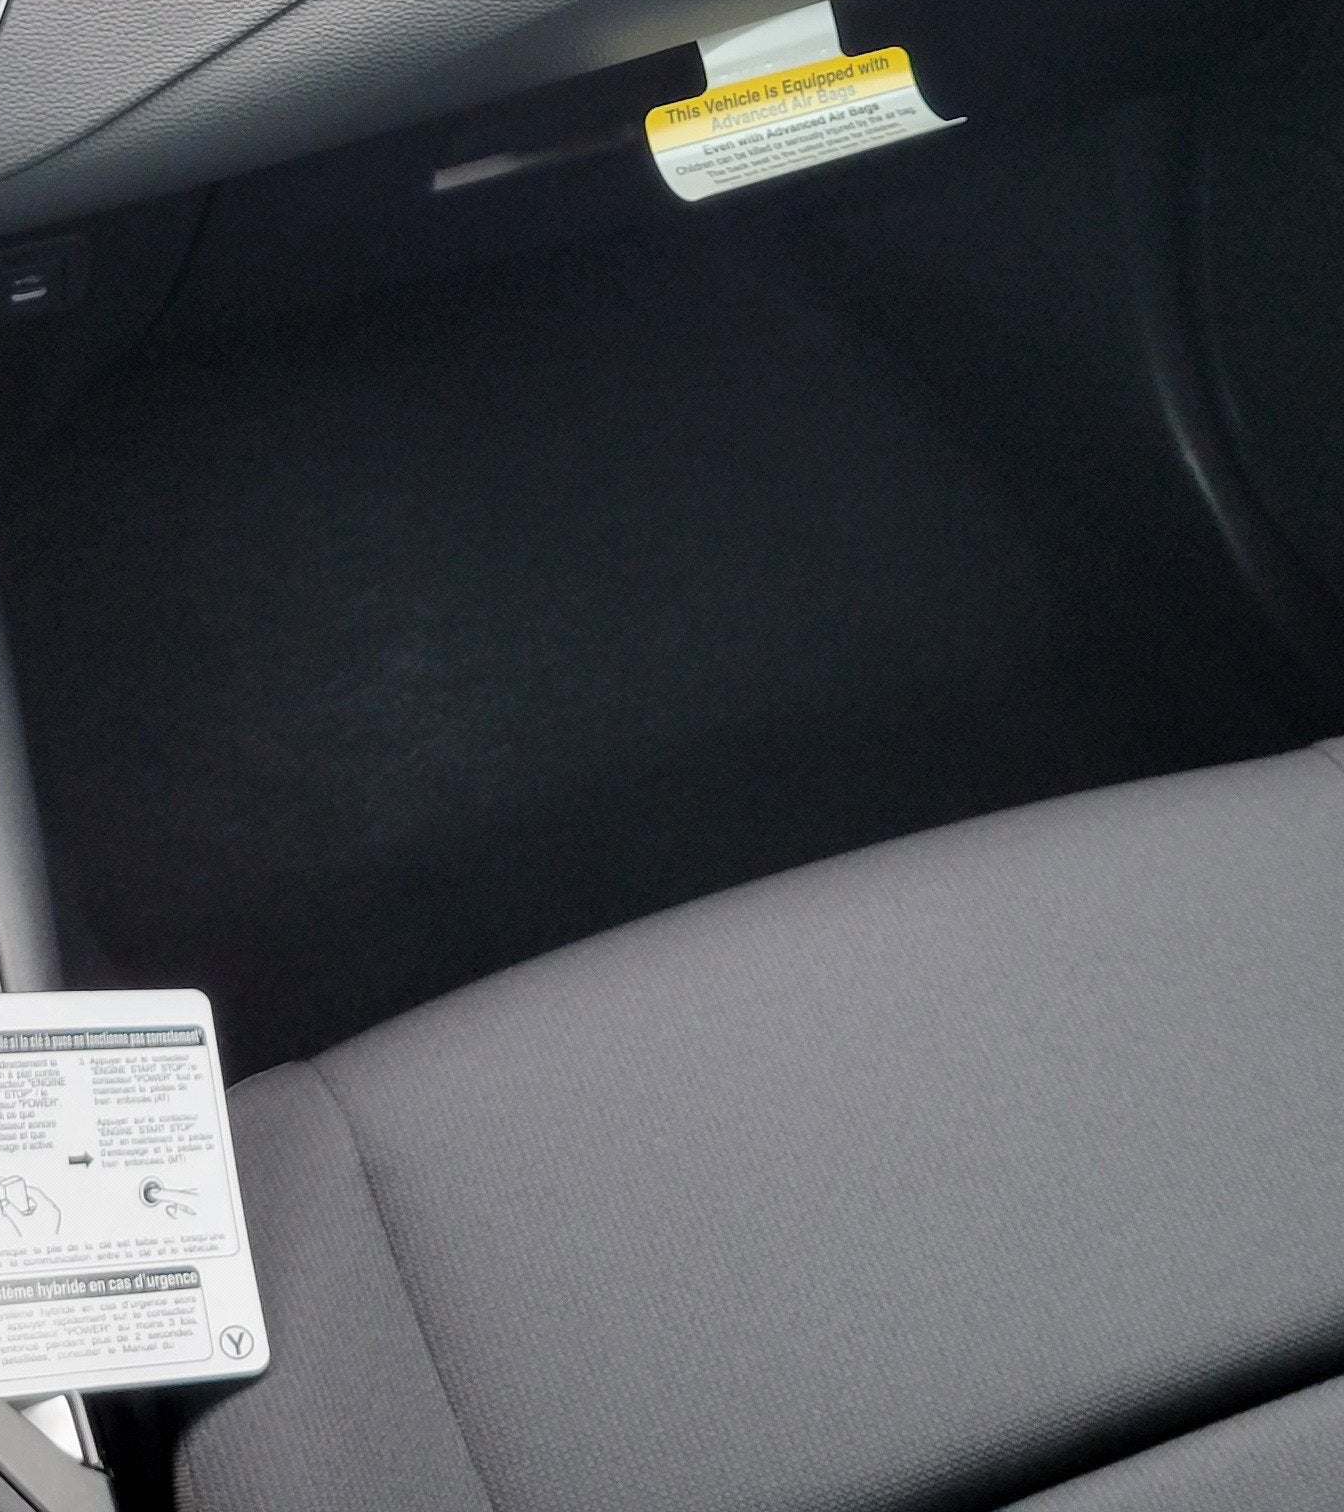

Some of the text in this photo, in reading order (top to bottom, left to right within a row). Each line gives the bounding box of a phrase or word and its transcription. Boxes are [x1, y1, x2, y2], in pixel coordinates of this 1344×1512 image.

[666, 55, 889, 125] This Vehicle is Equipped with
[710, 84, 856, 132] Advanced Air Bags
[703, 101, 880, 156] Even with Advanced Air Bags
[675, 159, 714, 176] Children
[37, 1278, 86, 1299] hybride
[90, 1279, 106, 1291] en
[109, 1277, 132, 1290] cas
[135, 1271, 198, 1289] d'urgence
[227, 1331, 245, 1355] Y
